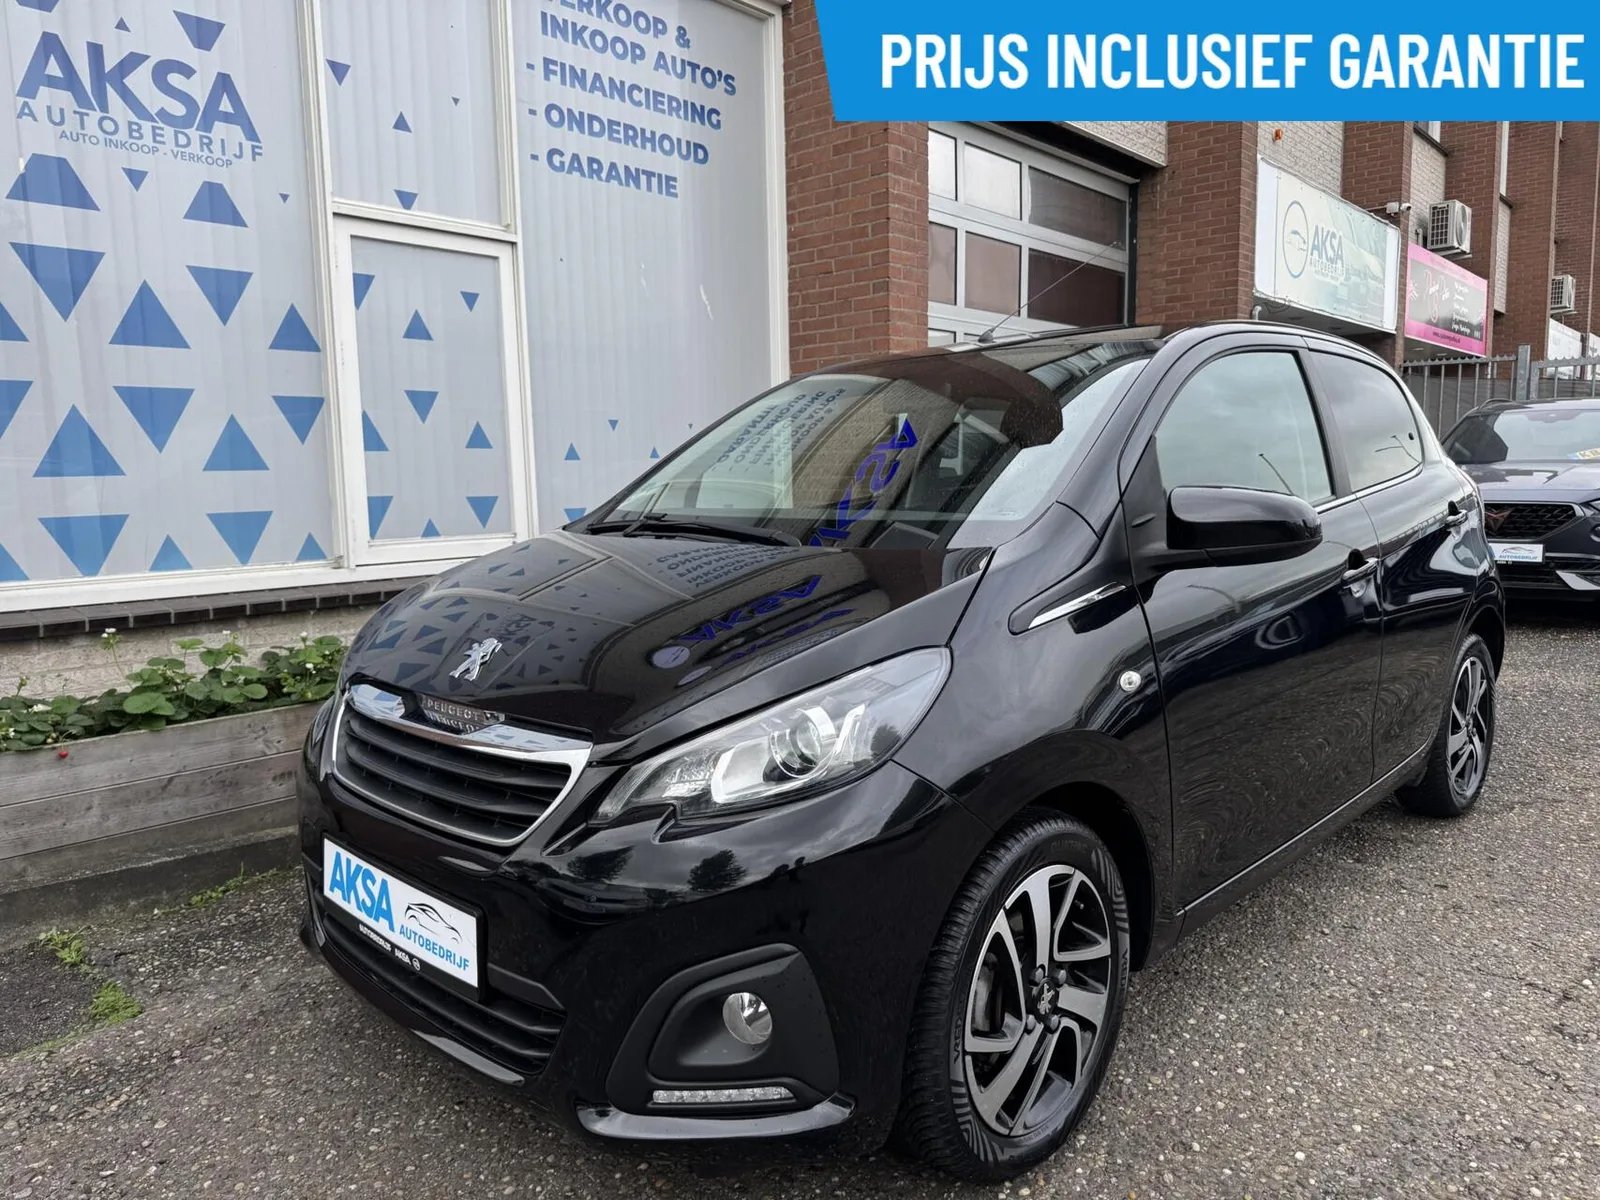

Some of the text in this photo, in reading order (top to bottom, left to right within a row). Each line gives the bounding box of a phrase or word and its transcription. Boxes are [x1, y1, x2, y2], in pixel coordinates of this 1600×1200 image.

[540, 10, 737, 97] INKOOP AUTO'S
[675, 25, 691, 50] &
[16, 31, 262, 144] AKSA
[542, 56, 721, 131] FINANCIERING
[16, 100, 264, 162] AUTOBEDRIJF
[59, 129, 101, 146] AUTO
[103, 137, 160, 157] INKOOP
[170, 149, 233, 169] VERKOOP
[544, 103, 709, 165] ONDERHOUD
[546, 147, 679, 199] GARANTIE
[1310, 224, 1345, 269] AKSA
[427, 698, 480, 721] PEUGEOT
[329, 851, 395, 932] AKSA
[399, 924, 470, 971] AUTOBEDRIJF
